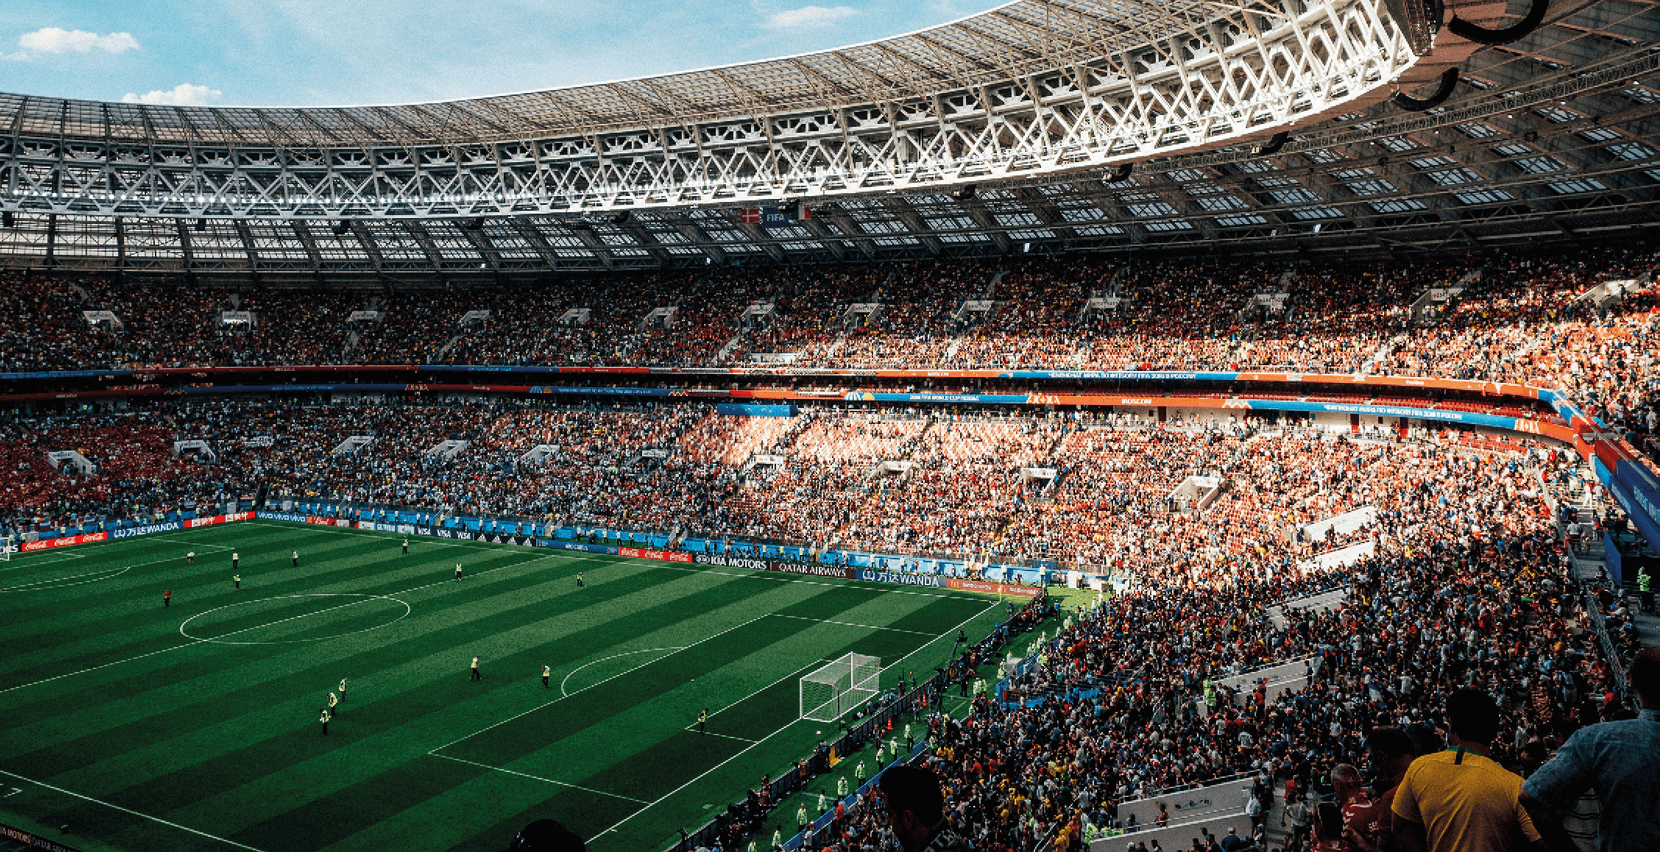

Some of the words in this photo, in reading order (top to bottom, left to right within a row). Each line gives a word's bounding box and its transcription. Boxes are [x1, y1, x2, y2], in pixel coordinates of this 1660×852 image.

[767, 213, 785, 222] FIFA
[273, 513, 289, 521] vivo
[290, 514, 306, 522] vivo
[147, 522, 179, 534] WANDA
[417, 527, 431, 536] VISA
[437, 529, 451, 538] VISA
[456, 531, 471, 540] VISA
[711, 556, 726, 566] KIA
[729, 558, 767, 570] MOTORS
[779, 563, 808, 573] QATAR
[810, 565, 847, 577] AIRWAYS
[900, 574, 940, 587] WANDA
